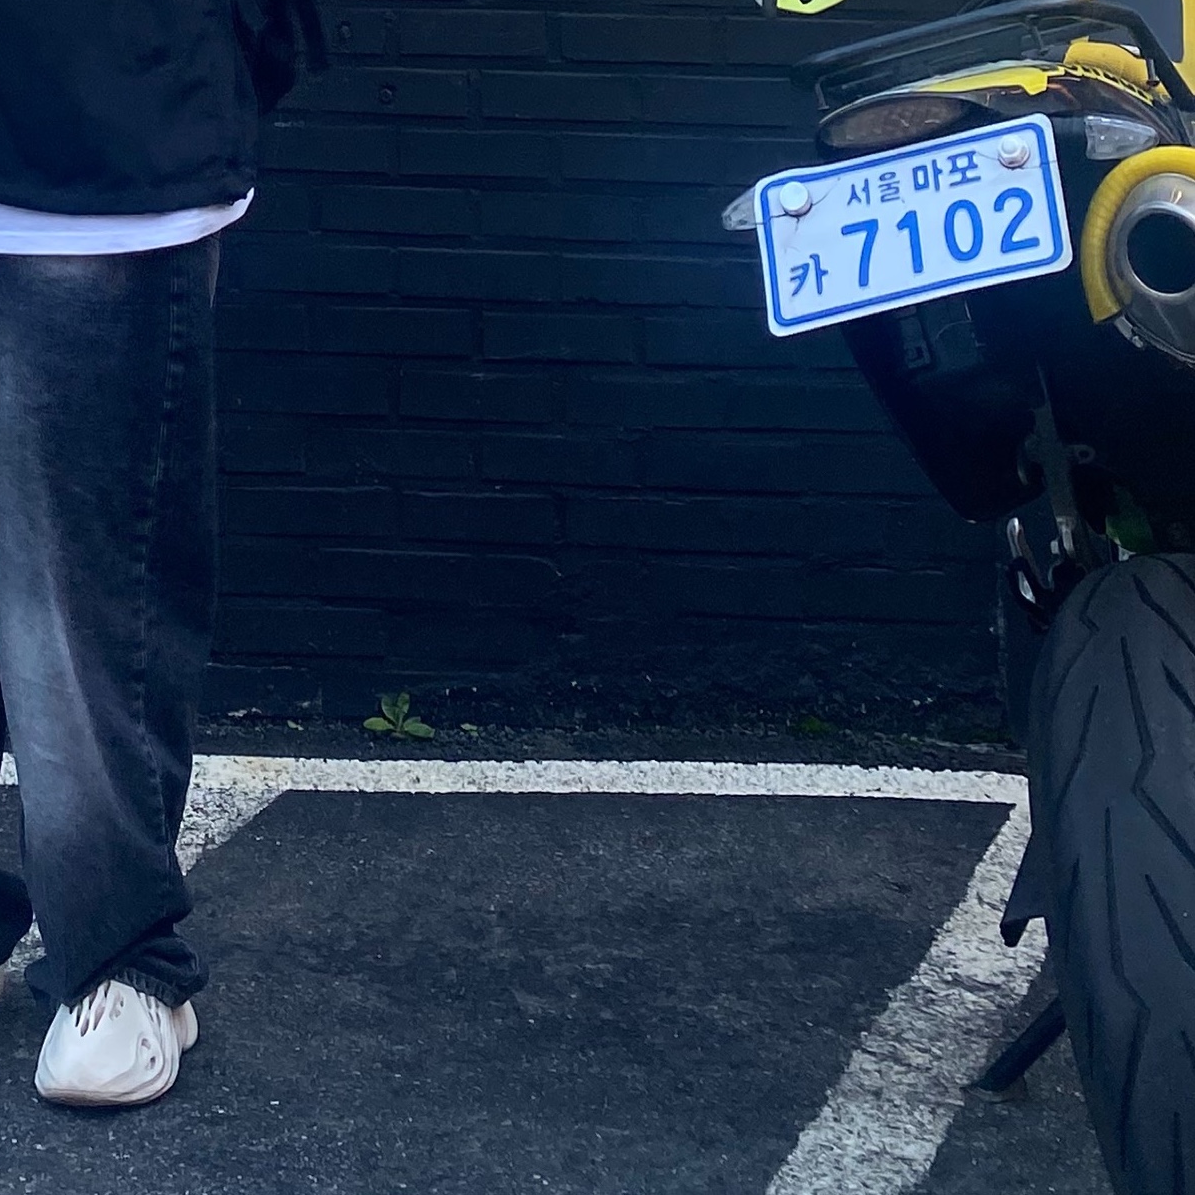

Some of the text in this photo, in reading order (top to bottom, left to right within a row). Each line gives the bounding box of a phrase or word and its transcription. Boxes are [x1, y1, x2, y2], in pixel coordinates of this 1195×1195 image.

[847, 150, 982, 206] 서울 마포
[841, 187, 1040, 288] 7102
